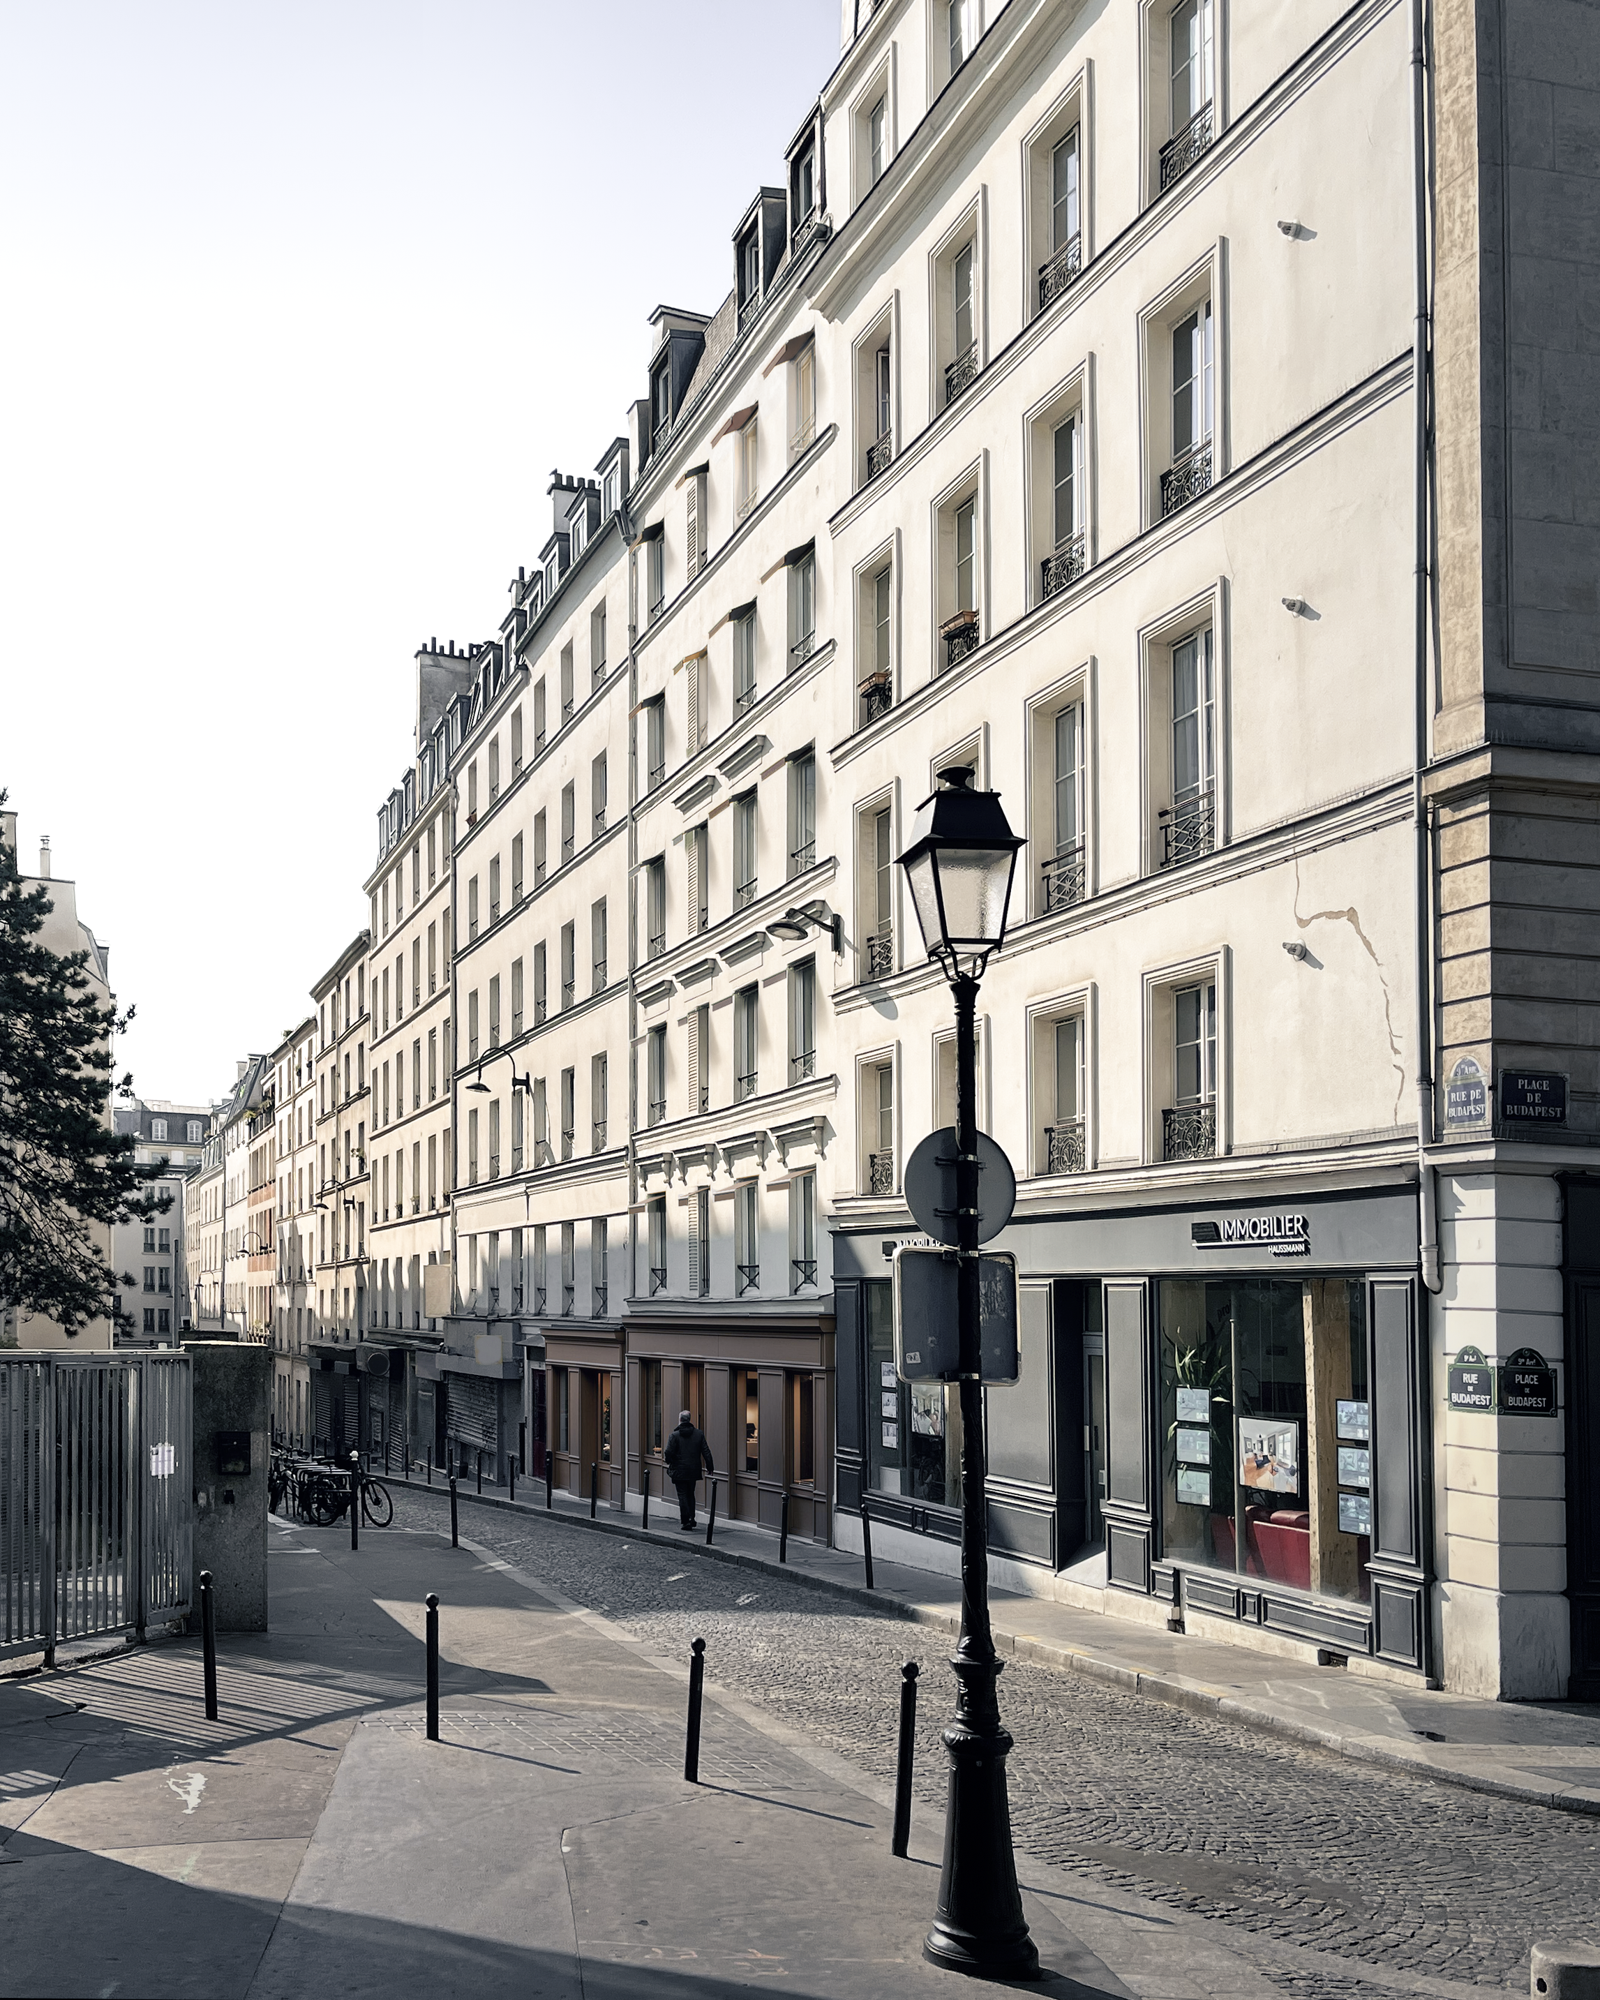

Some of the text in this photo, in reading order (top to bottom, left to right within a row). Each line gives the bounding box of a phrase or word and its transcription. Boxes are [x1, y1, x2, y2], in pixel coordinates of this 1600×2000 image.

[1518, 1079, 1549, 1090] PLACE
[1451, 1089, 1481, 1102] RUE DE
[1527, 1093, 1541, 1103] DE
[1449, 1104, 1485, 1117] BUDAPEST
[1506, 1104, 1562, 1117] BUDAPEST
[1220, 1214, 1304, 1239] IMMOBILIER
[1268, 1243, 1305, 1253] HAUSSMANN
[1463, 1373, 1478, 1384] RUE
[1515, 1374, 1539, 1385] PLACE
[1451, 1392, 1491, 1406] BUDAPEST
[1508, 1396, 1547, 1408] BUDAPEST
